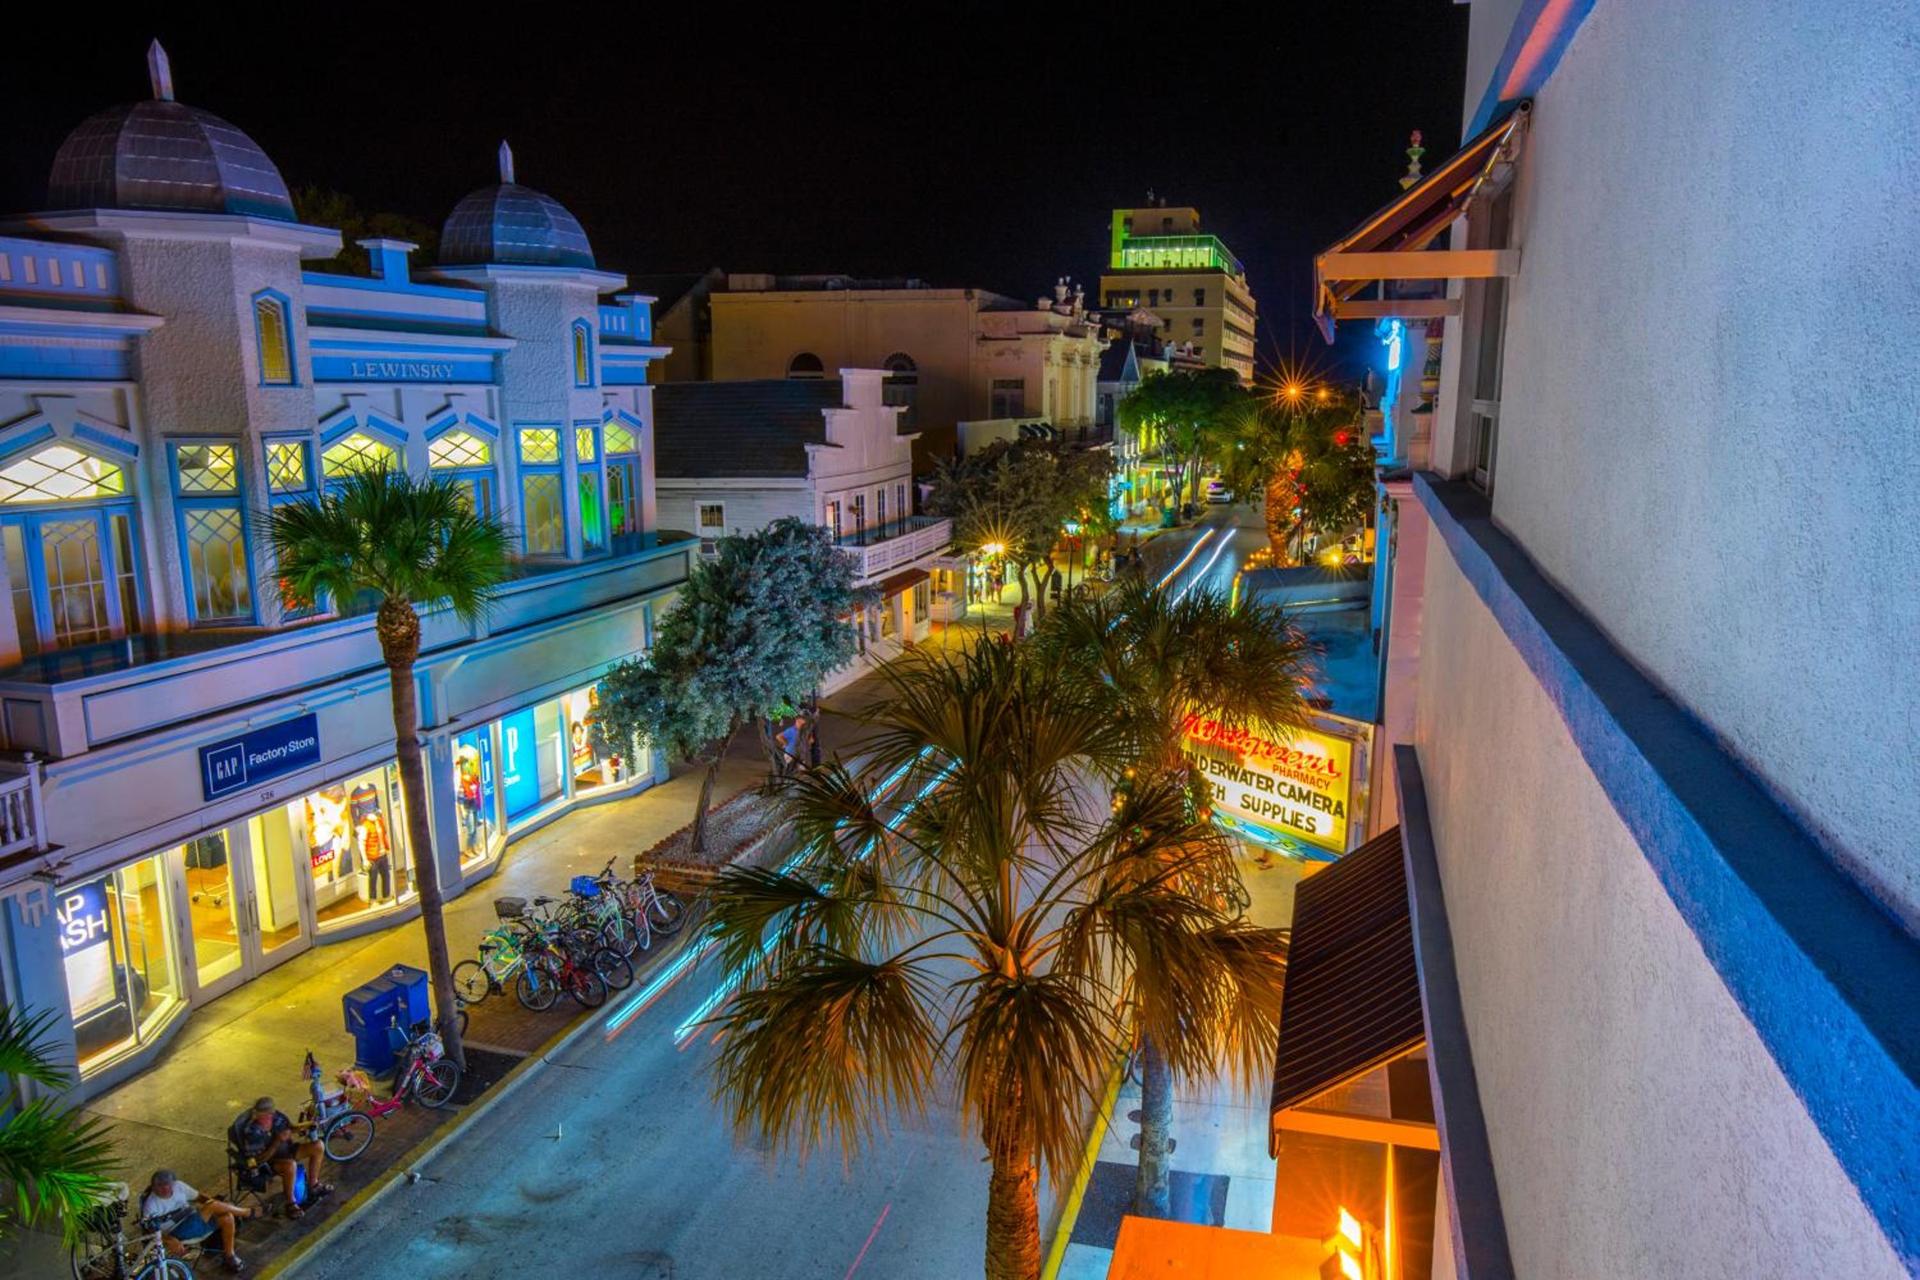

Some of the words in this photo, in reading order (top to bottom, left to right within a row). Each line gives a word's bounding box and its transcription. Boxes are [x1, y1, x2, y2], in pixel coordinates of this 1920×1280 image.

[352, 362, 453, 378] LEWINSKY
[216, 756, 238, 780] GAP
[249, 744, 287, 766] Factory
[288, 736, 315, 753] Store
[1272, 764, 1331, 791] PHARMACY
[1240, 793, 1318, 834] SUPPLIES
[1277, 781, 1345, 819] CAMERA
